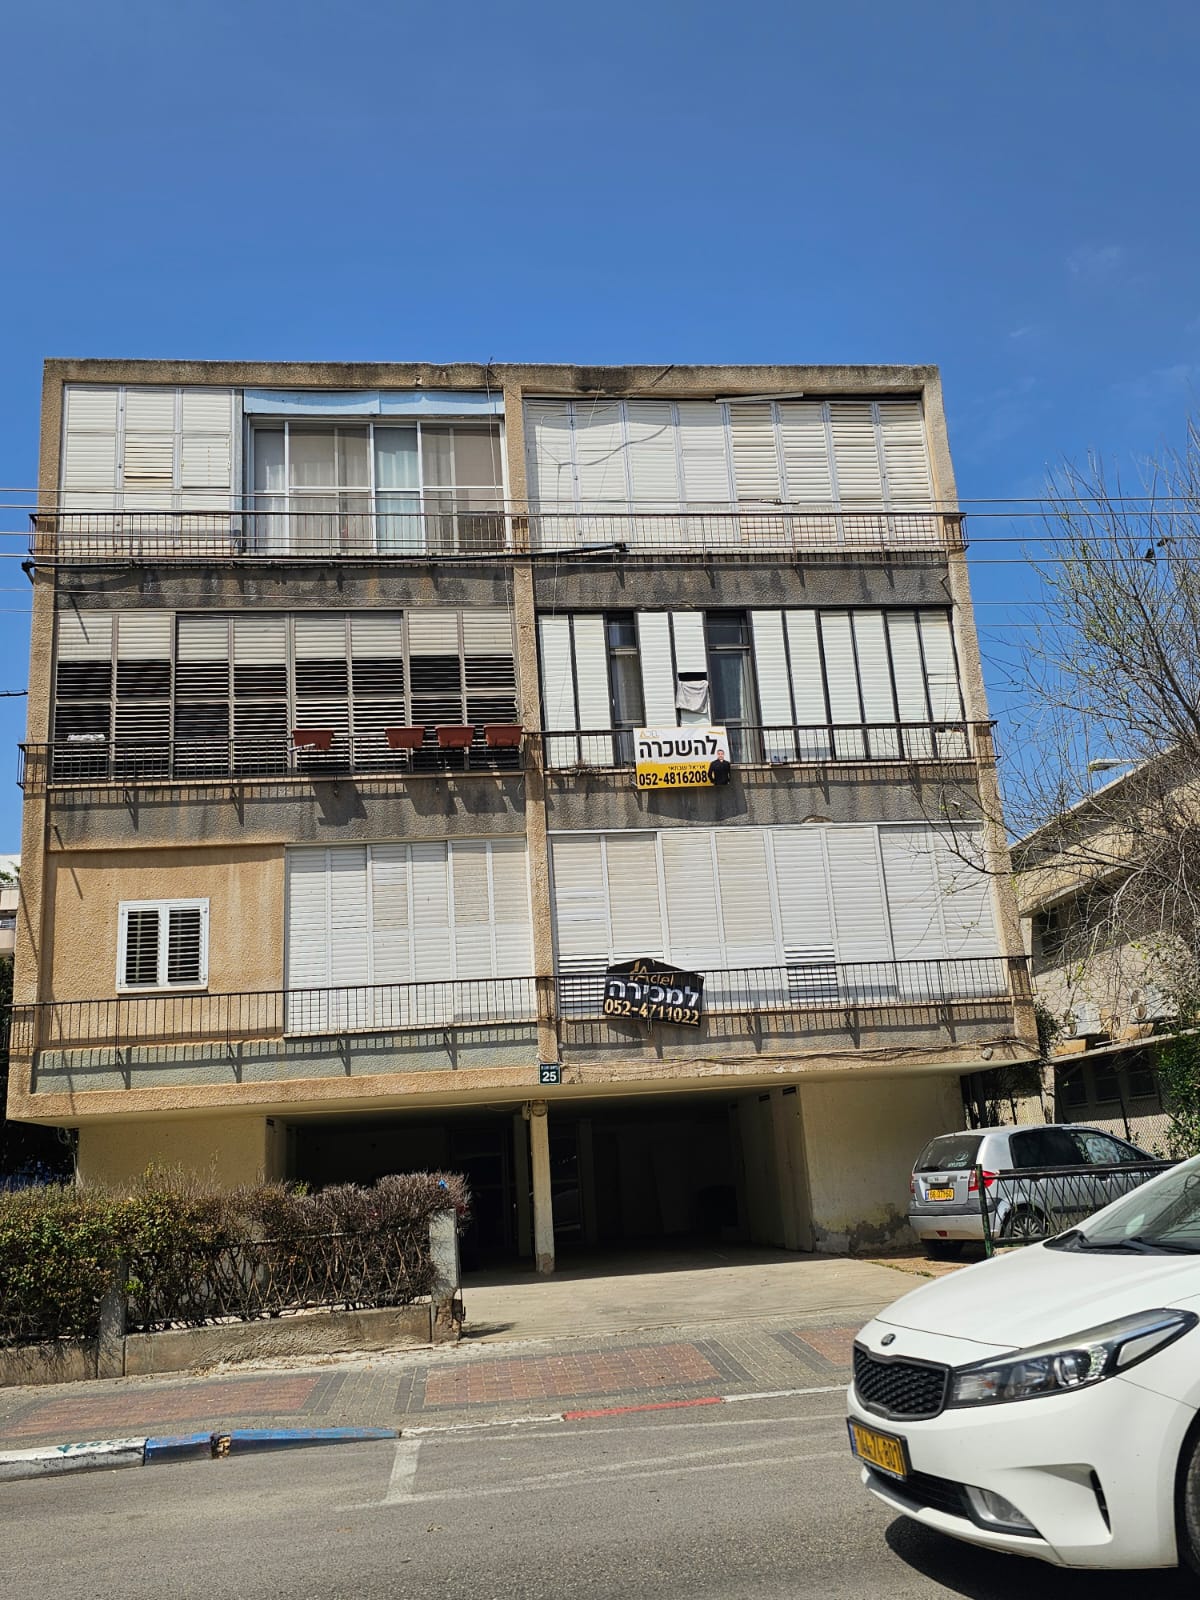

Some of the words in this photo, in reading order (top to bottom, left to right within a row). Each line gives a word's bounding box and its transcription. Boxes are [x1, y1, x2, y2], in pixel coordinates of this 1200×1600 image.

[639, 735, 718, 758] להשכרה
[639, 771, 708, 786] 052-4816208
[609, 980, 699, 1007] למכירה
[604, 998, 699, 1025] 052-4711022
[542, 1071, 557, 1082] 25
